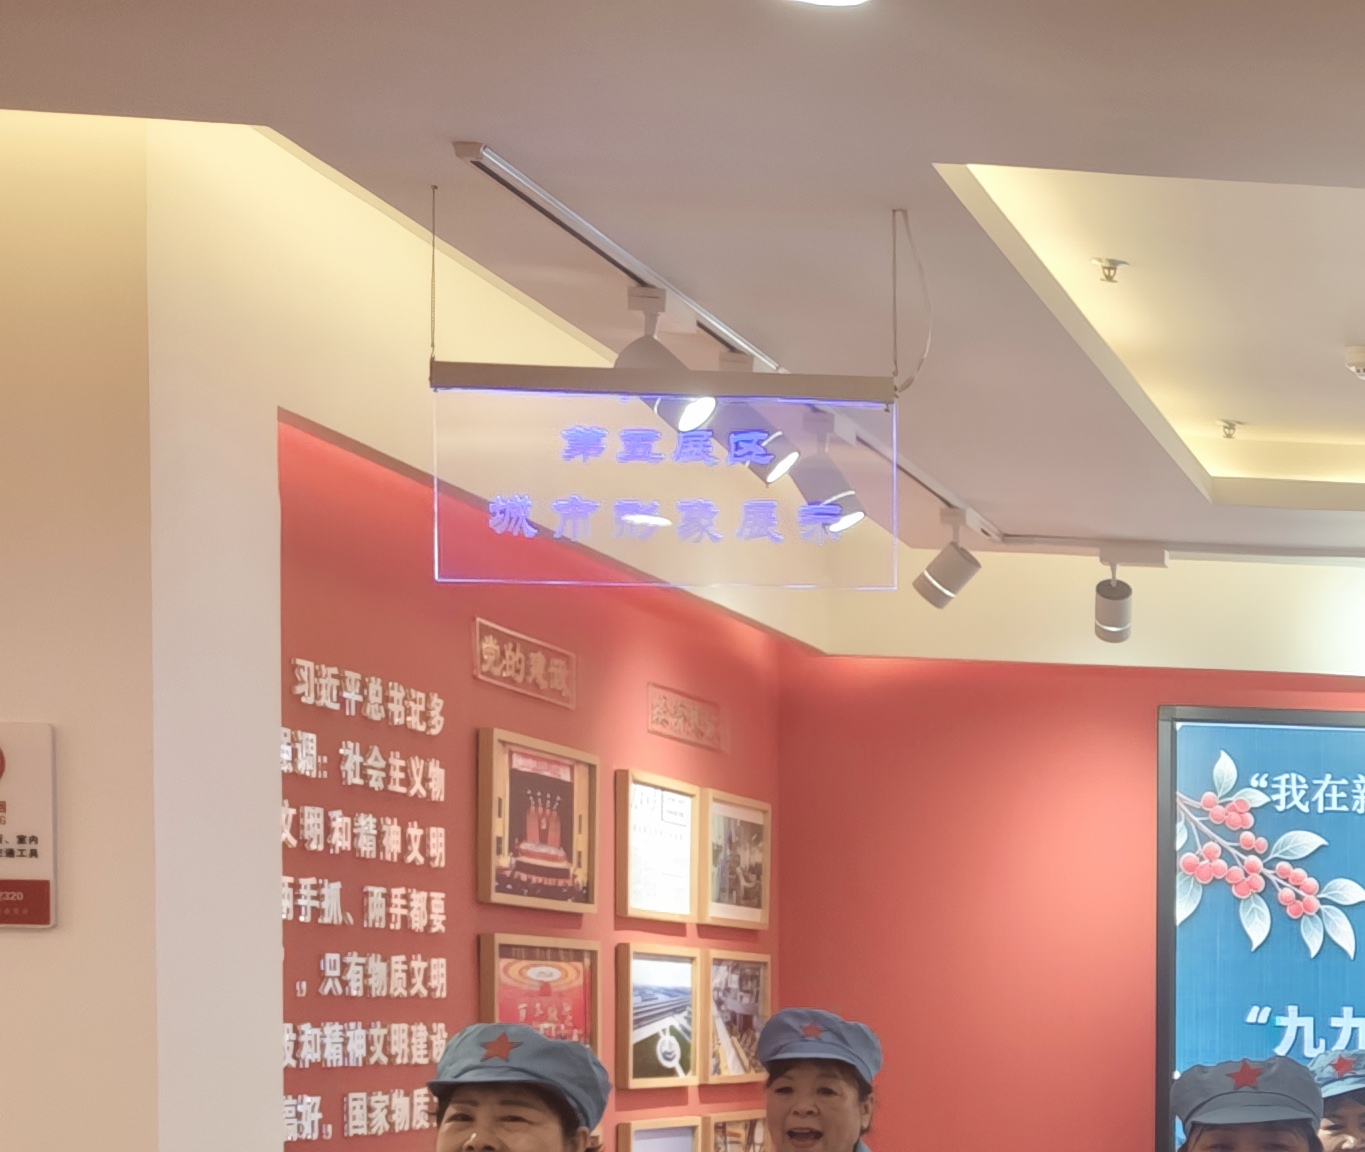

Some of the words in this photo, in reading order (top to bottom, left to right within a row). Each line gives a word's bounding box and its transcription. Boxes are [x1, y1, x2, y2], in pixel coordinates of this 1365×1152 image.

[560, 425, 774, 466] 第五展区
[481, 634, 571, 697] 党的建设
[291, 657, 444, 735] 习近平总书记多
[283, 1087, 438, 1141] 搞好，国家物质
